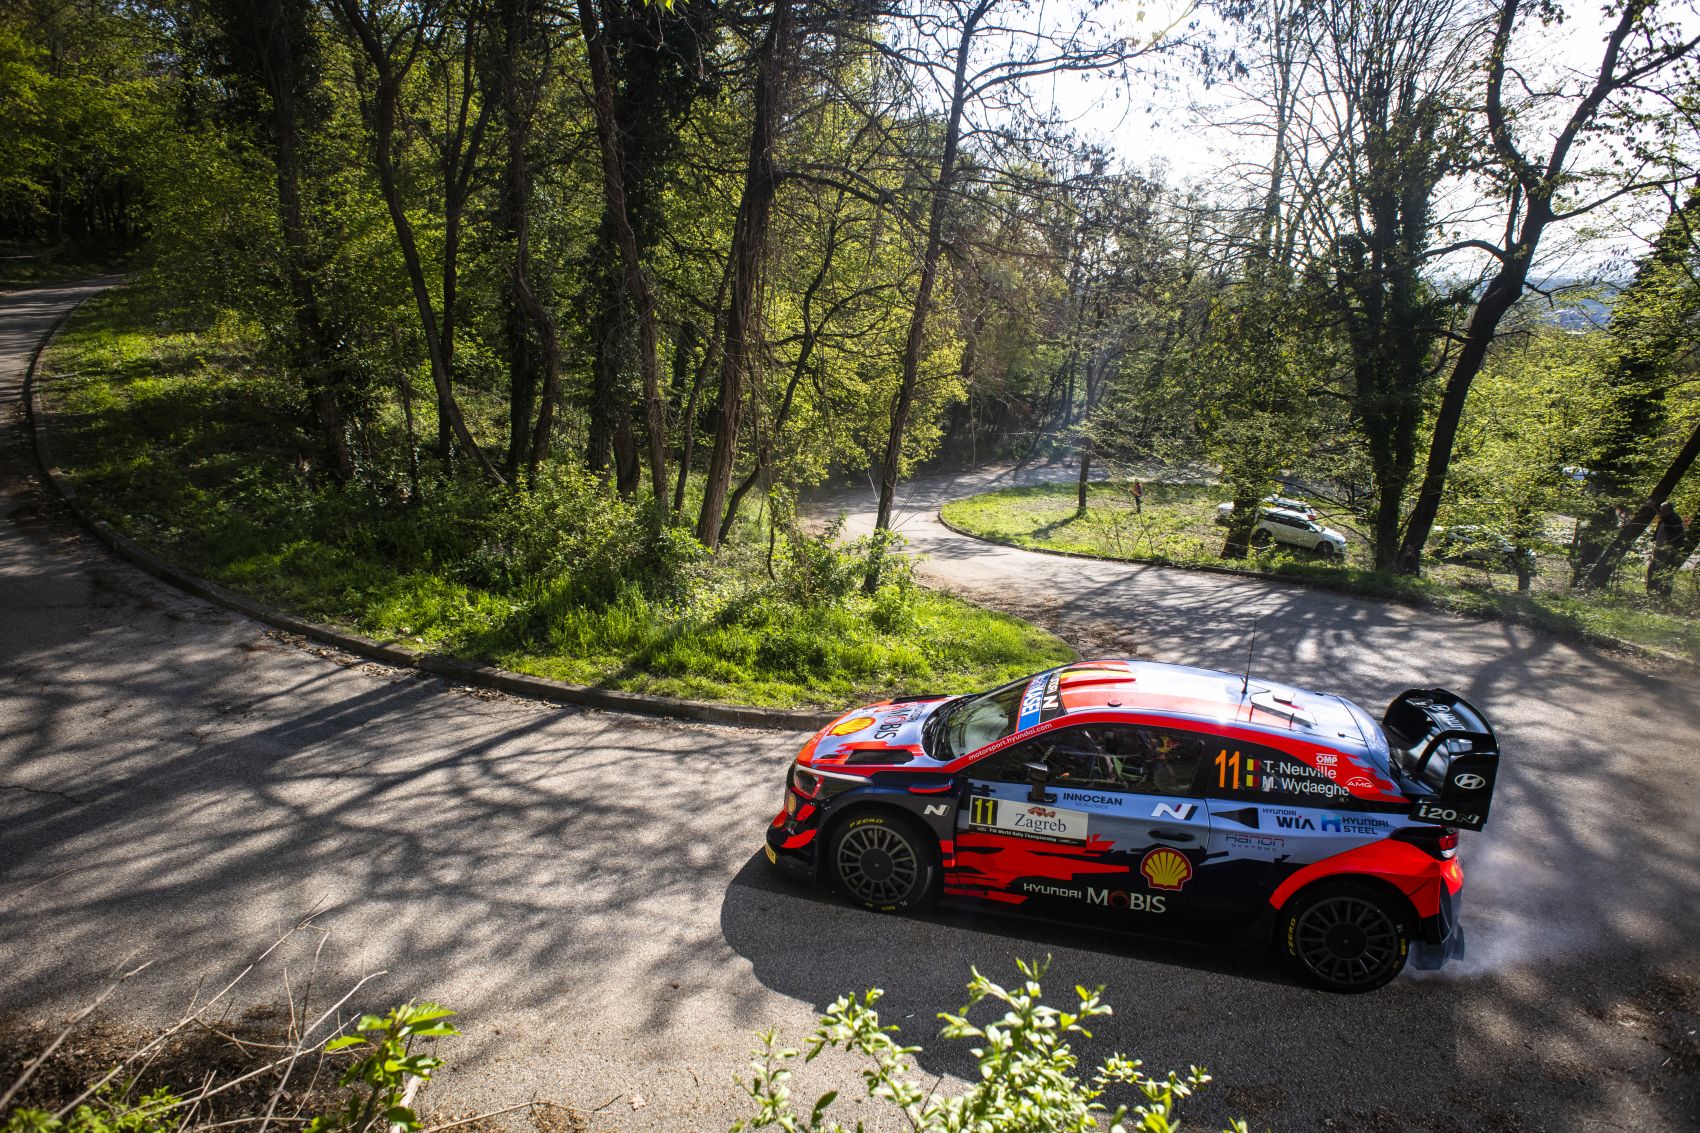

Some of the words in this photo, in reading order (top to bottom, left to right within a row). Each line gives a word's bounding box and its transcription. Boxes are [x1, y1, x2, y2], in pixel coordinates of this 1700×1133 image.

[968, 723, 1053, 760] motorsport.hyundai.com
[1215, 750, 1241, 789] 11
[1263, 760, 1275, 773] T.
[1279, 762, 1337, 779] Neuville
[1316, 754, 1338, 766] OMP
[1262, 776, 1278, 790] M.
[1281, 777, 1349, 798] Wydaeghe
[1063, 792, 1123, 806] INNOCEAN
[974, 798, 994, 825] 11
[1262, 807, 1297, 816] HYUNDAI
[1014, 813, 1067, 833] Zagreb
[1342, 817, 1389, 828] HYUNDAI
[1343, 826, 1378, 835] STEEL
[1024, 833, 1057, 842] Championship
[1023, 882, 1082, 899] HYUNDAI
[1086, 886, 1167, 914] MOBIS
